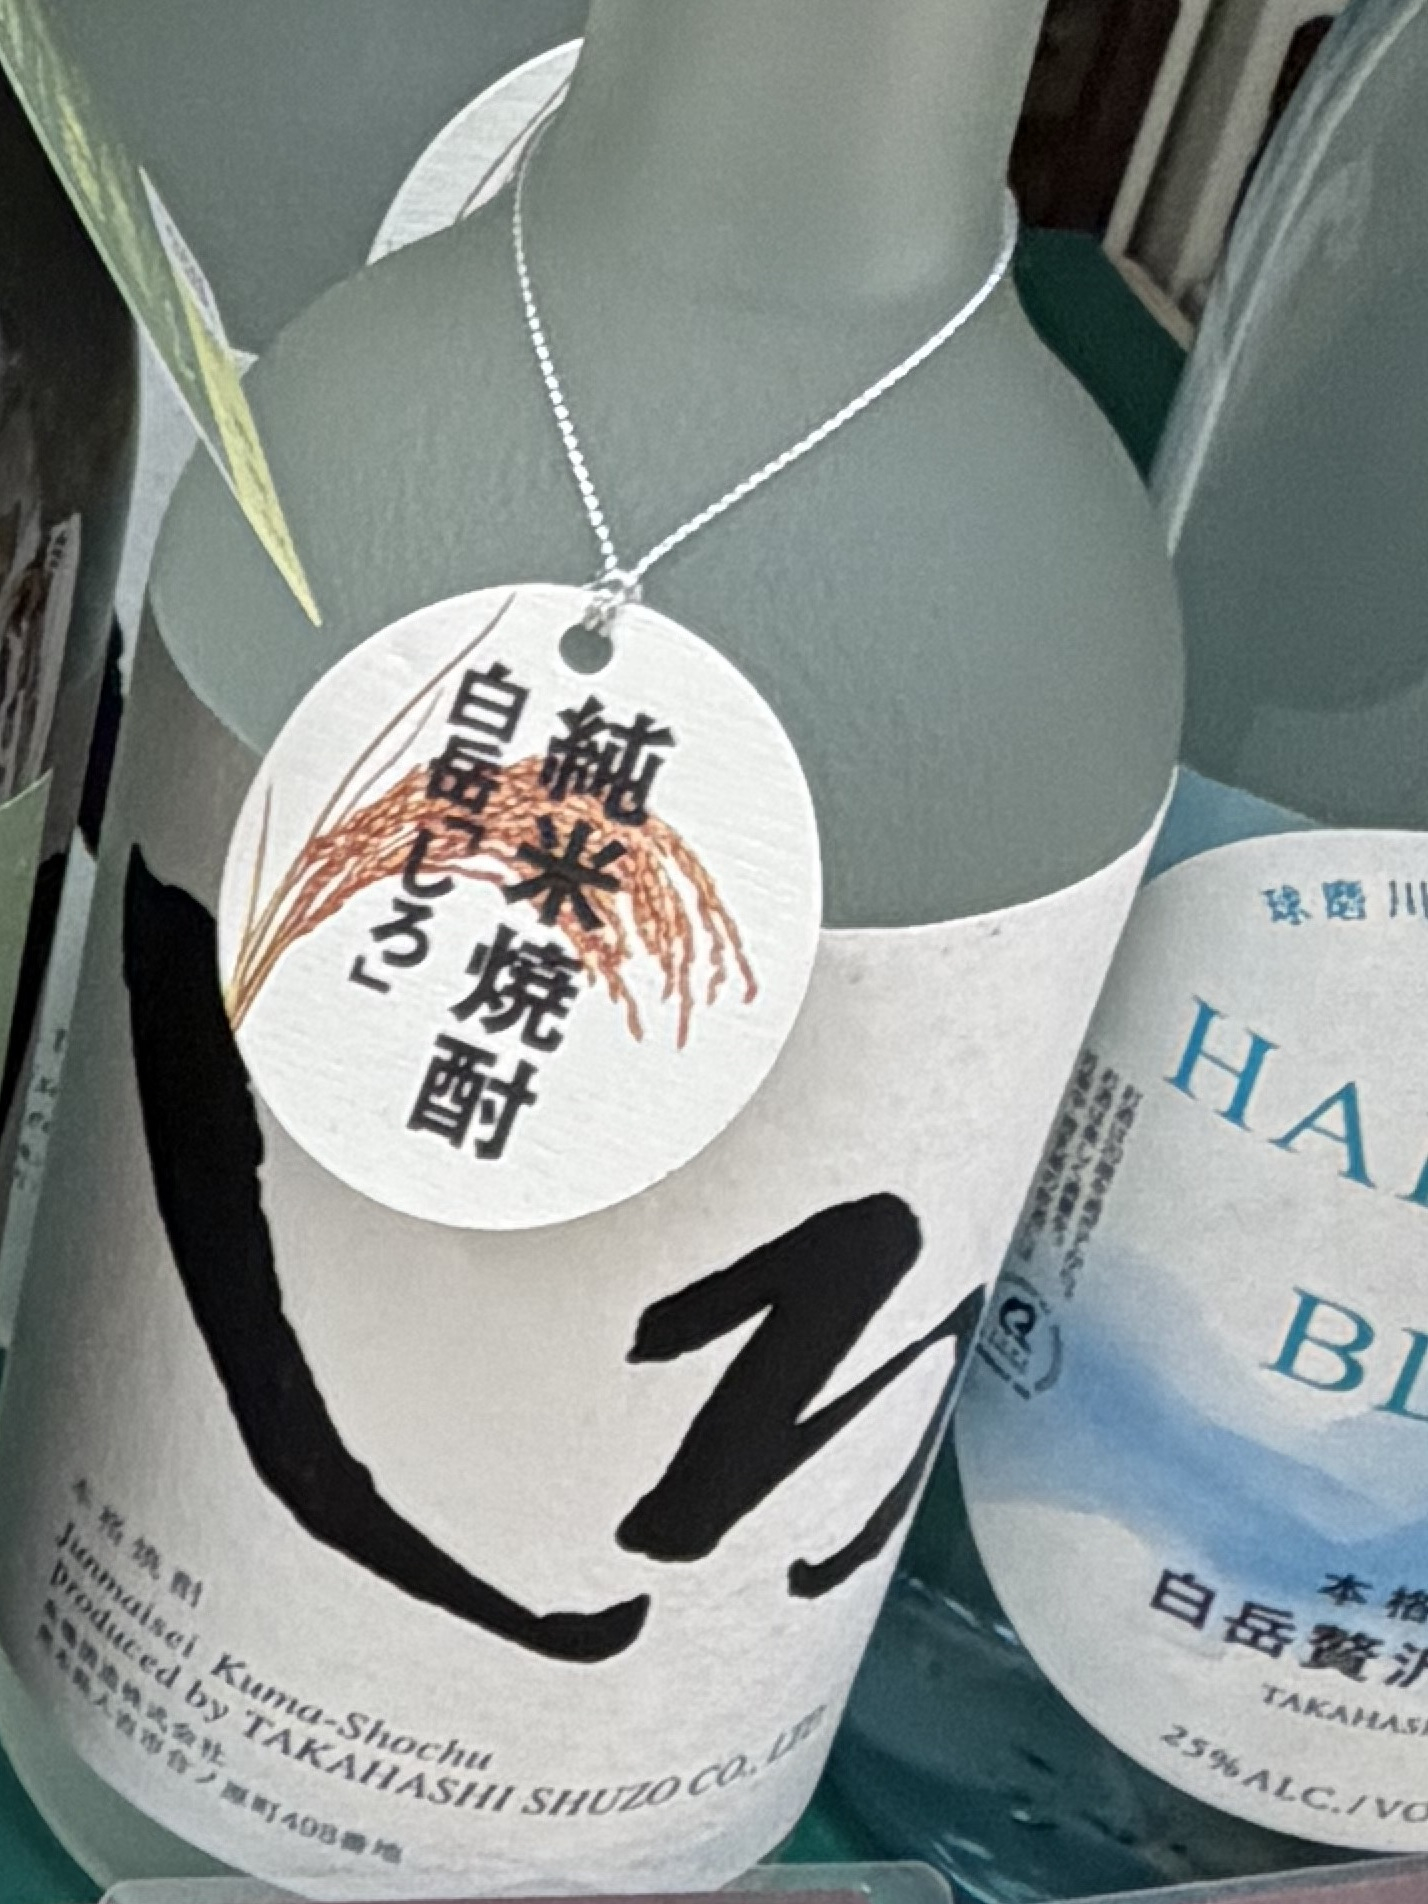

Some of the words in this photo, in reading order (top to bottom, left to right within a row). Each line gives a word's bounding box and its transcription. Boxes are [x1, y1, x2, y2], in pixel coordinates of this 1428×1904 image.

[404, 693, 676, 1163] 純米焼酎
[1162, 994, 1428, 1208] HA
[48, 1558, 183, 1692] produced
[184, 1679, 231, 1725] by
[243, 1708, 517, 1813] TAKAHASHI
[520, 1775, 683, 1817] SHUZO
[54, 1521, 201, 1659] Junmaisei
[210, 1651, 495, 1772] Kuma-Shochu
